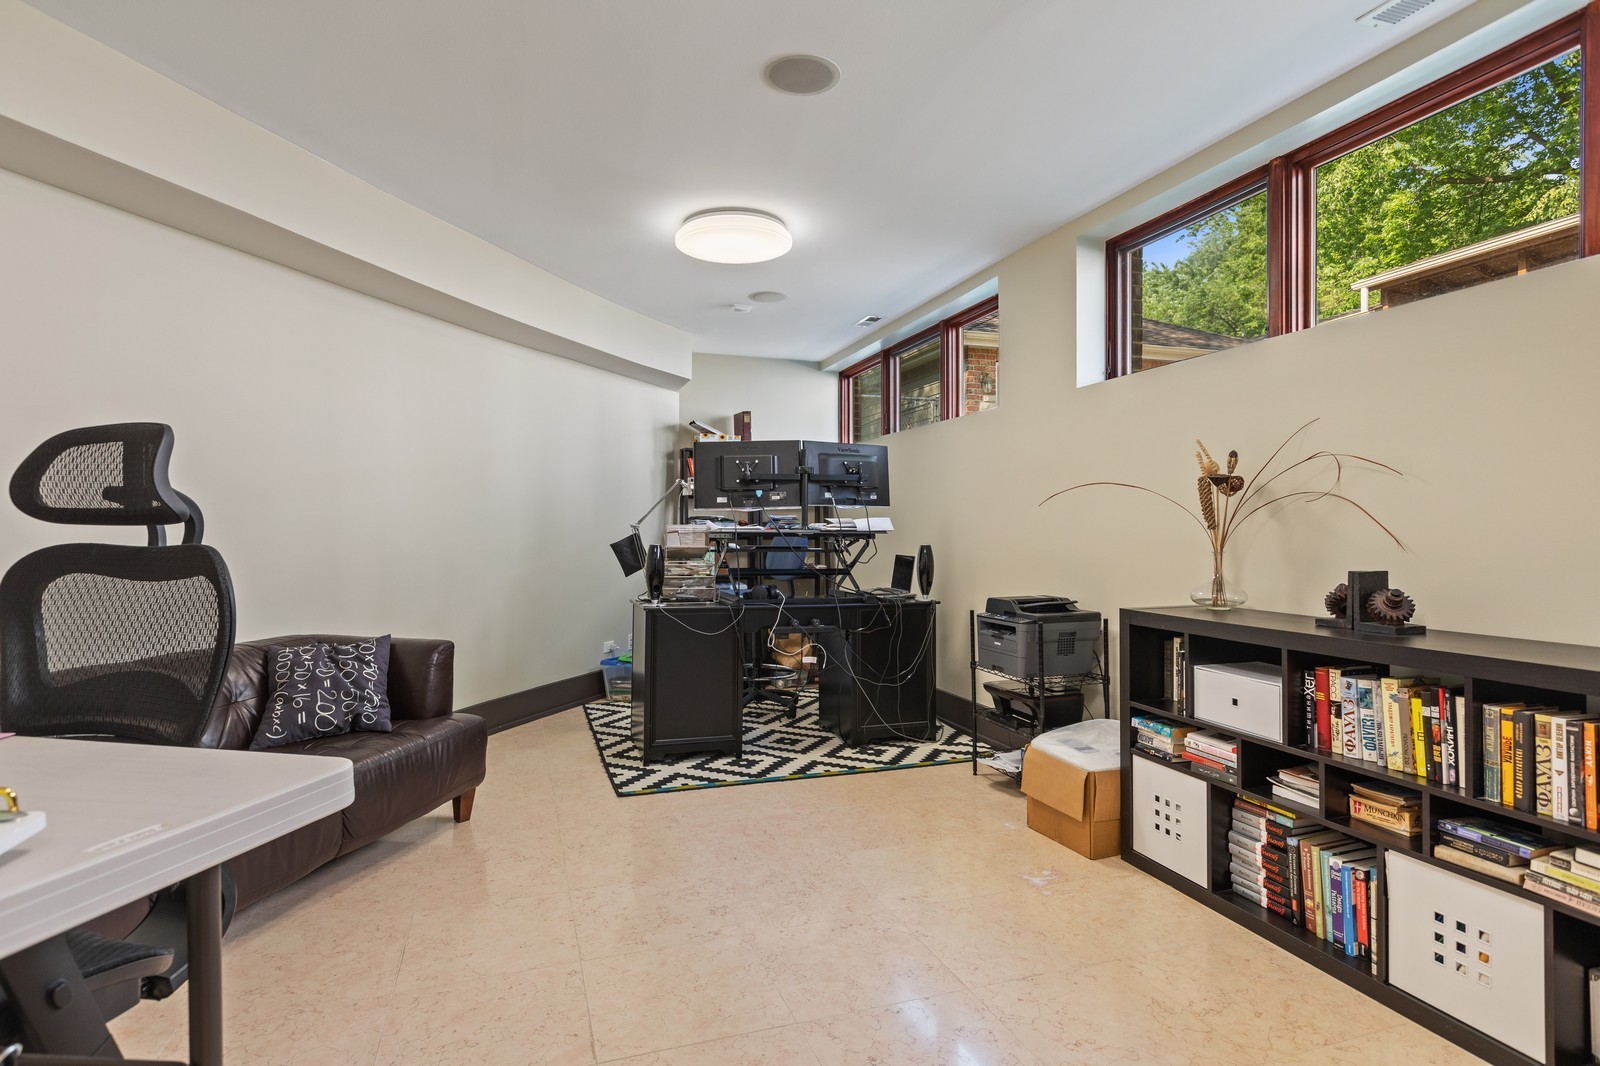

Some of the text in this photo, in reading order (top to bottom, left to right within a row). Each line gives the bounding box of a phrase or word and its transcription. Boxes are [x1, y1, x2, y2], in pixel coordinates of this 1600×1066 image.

[1343, 698, 1356, 752] ФАУЛЗ
[1362, 718, 1376, 751] ФАУЛЗ
[1446, 726, 1456, 766] ХОКИНГ
[1502, 736, 1512, 764] УДУШЬЕ
[1536, 744, 1552, 808] ФАУЛЗ
[1364, 804, 1406, 822] MUNCHKIN
